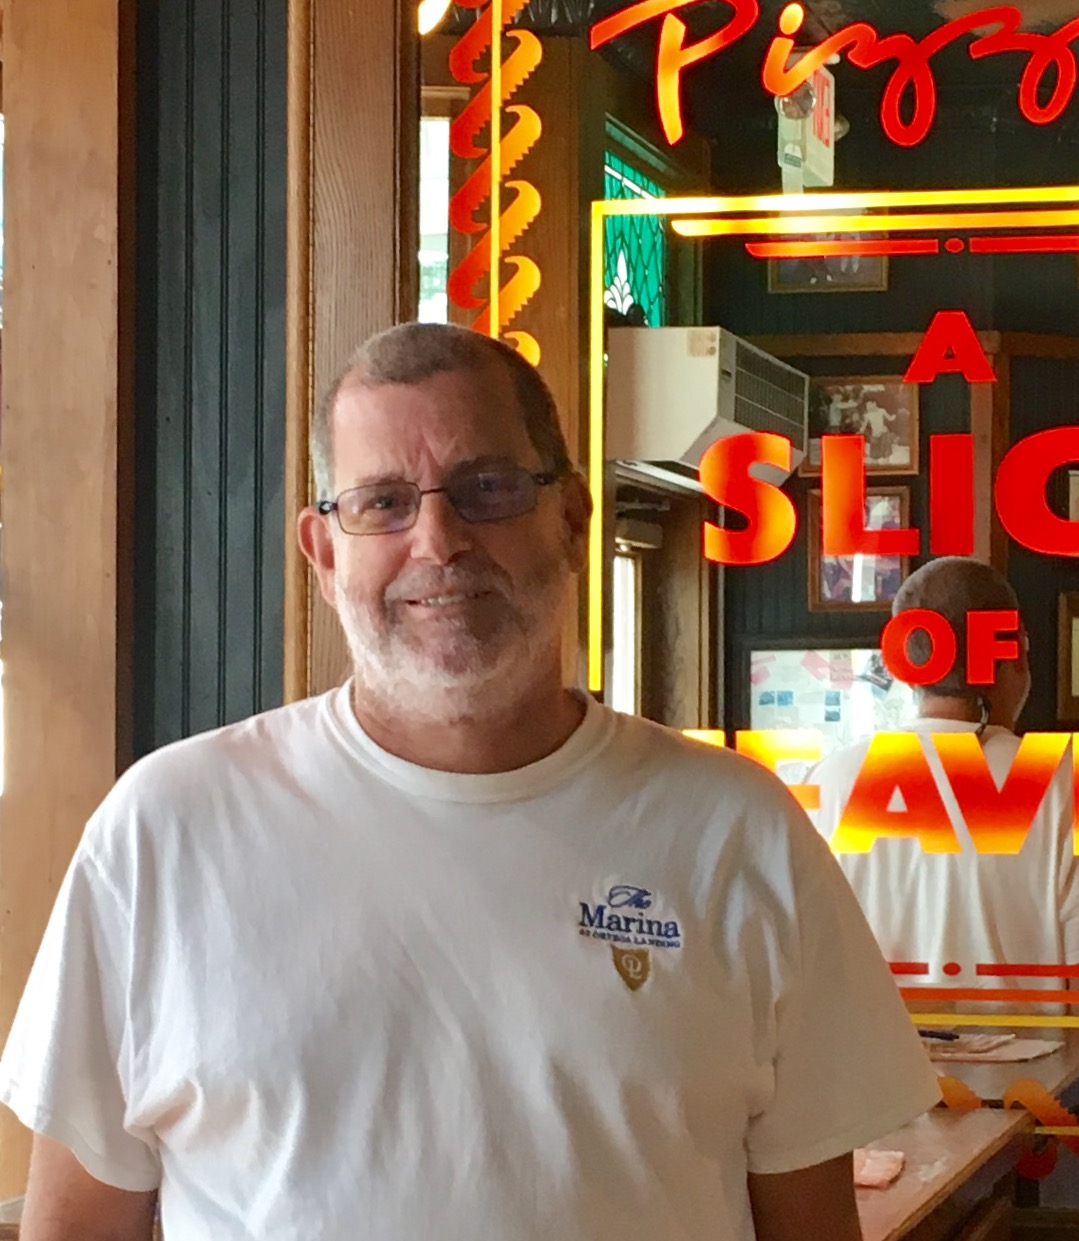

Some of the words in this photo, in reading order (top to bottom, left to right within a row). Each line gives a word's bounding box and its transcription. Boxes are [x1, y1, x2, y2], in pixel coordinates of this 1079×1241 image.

[902, 310, 997, 384] A
[881, 608, 1019, 687] OF
[579, 901, 681, 939] Marina
